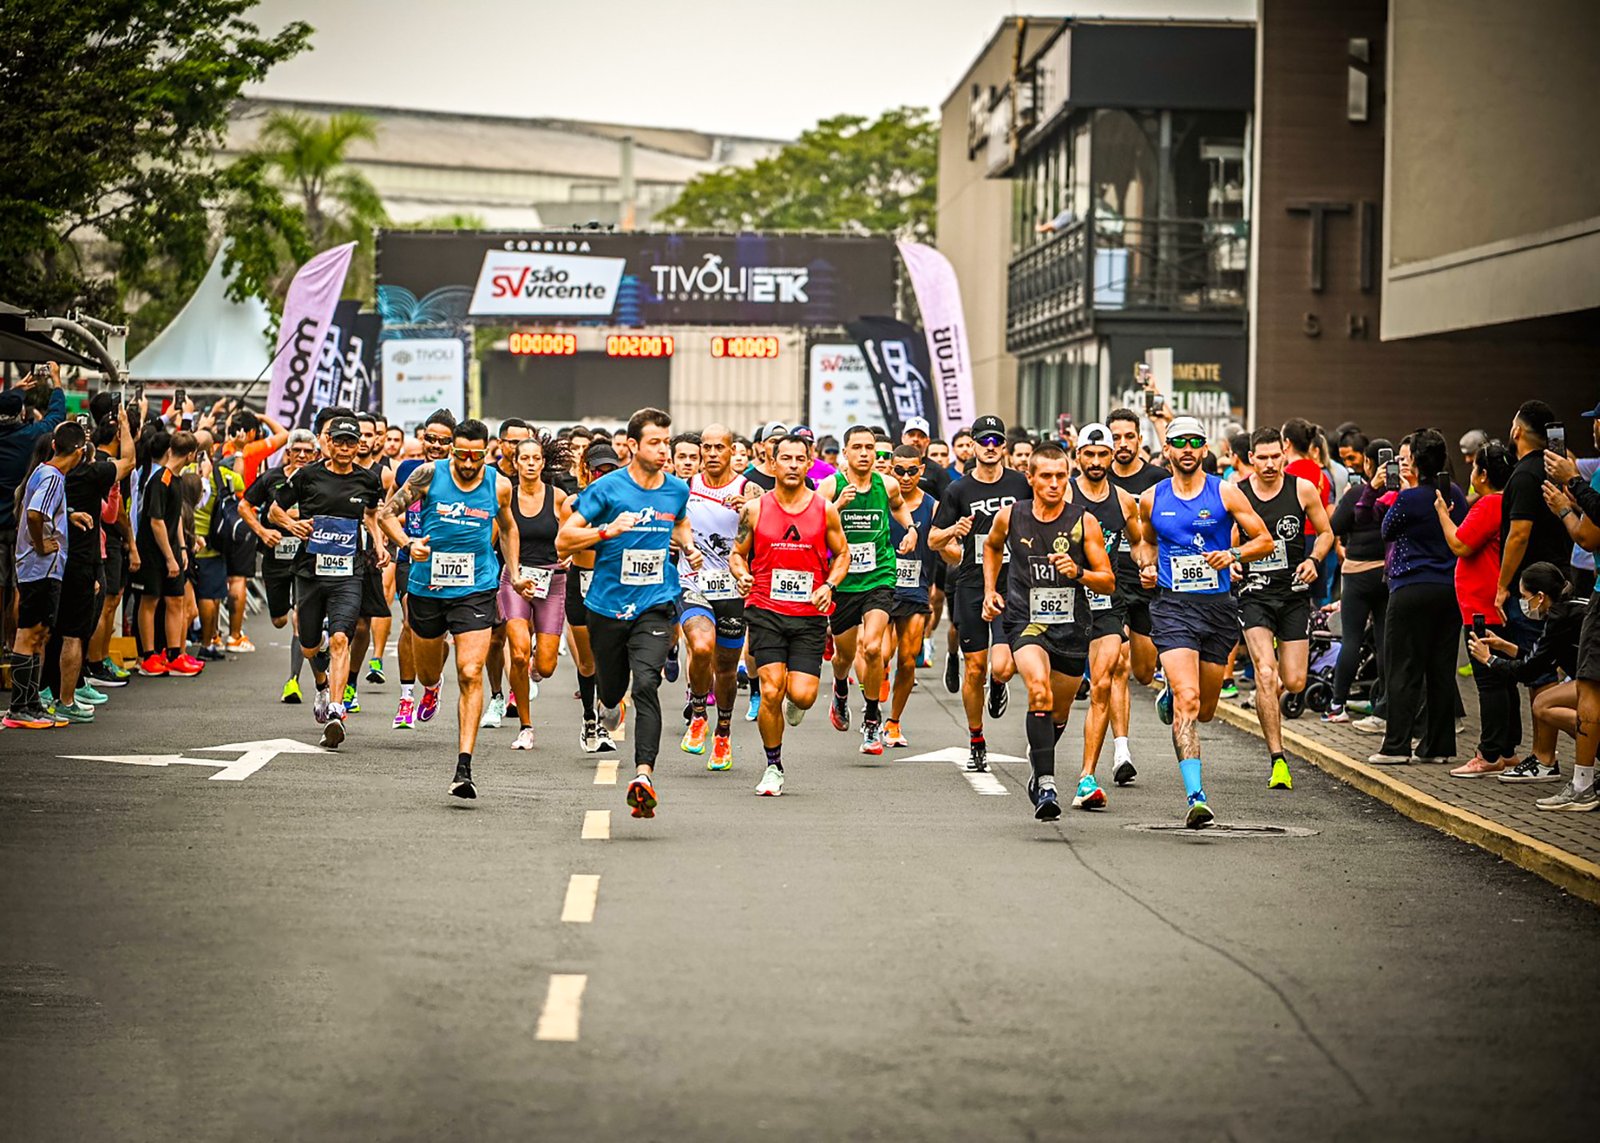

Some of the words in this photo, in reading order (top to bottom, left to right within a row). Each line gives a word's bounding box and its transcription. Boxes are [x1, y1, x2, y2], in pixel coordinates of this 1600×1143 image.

[504, 240, 591, 252] CORRIDA
[492, 267, 531, 298] SV
[530, 267, 569, 284] são
[525, 283, 606, 299] vicente
[753, 275, 809, 303] 21K
[844, 513, 871, 521] Unimed
[312, 528, 354, 545] danny
[323, 556, 344, 567] 1046
[850, 553, 865, 563] 47
[440, 564, 462, 575] 1170
[632, 562, 654, 573] 1169
[1182, 567, 1203, 579] 966
[706, 580, 725, 590] 1016
[780, 580, 800, 591] 964
[1040, 600, 1062, 612] 962
